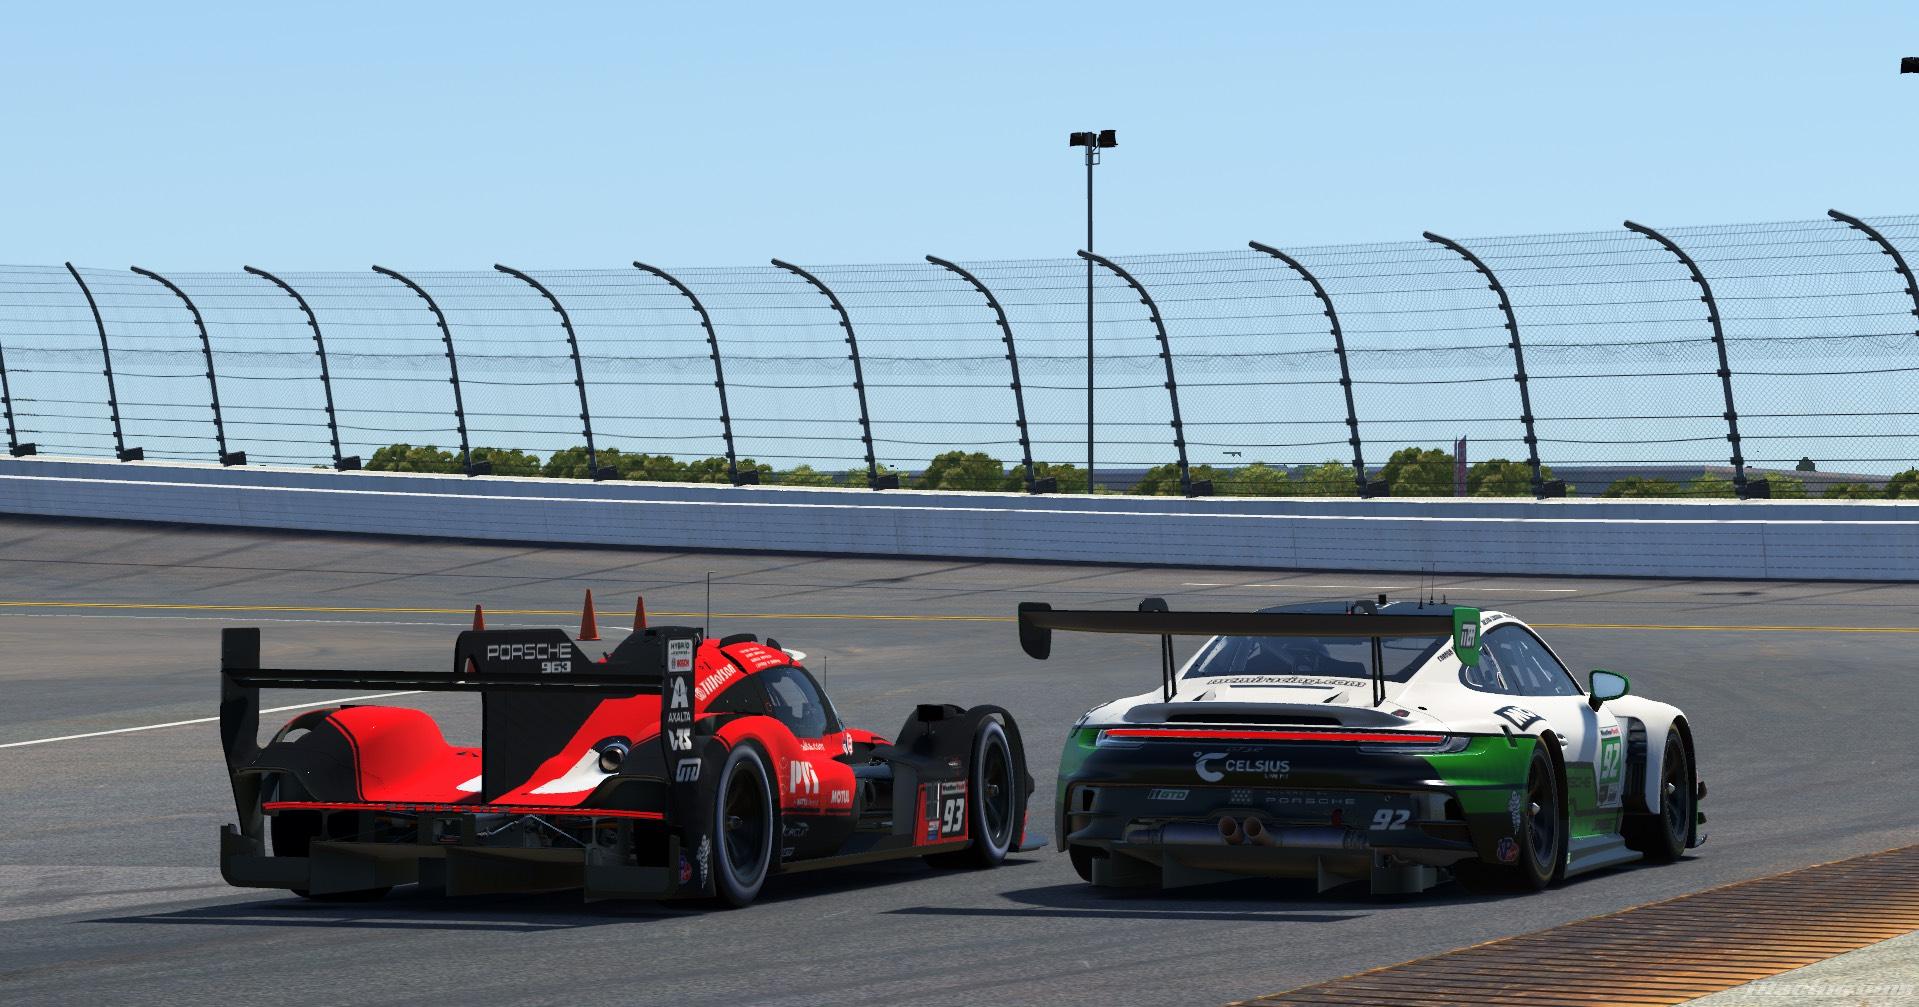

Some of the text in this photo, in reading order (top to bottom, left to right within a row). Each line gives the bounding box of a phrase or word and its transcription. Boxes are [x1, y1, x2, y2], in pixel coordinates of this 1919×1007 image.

[488, 643, 572, 661] PORSCHE
[541, 661, 572, 674] 963
[668, 711, 691, 723] AXALTA
[1225, 759, 1290, 773] CELSIUS
[1601, 743, 1621, 779] 92
[1265, 797, 1356, 805] PORSCHE
[941, 798, 965, 834] 93
[1369, 809, 1411, 831] 92
